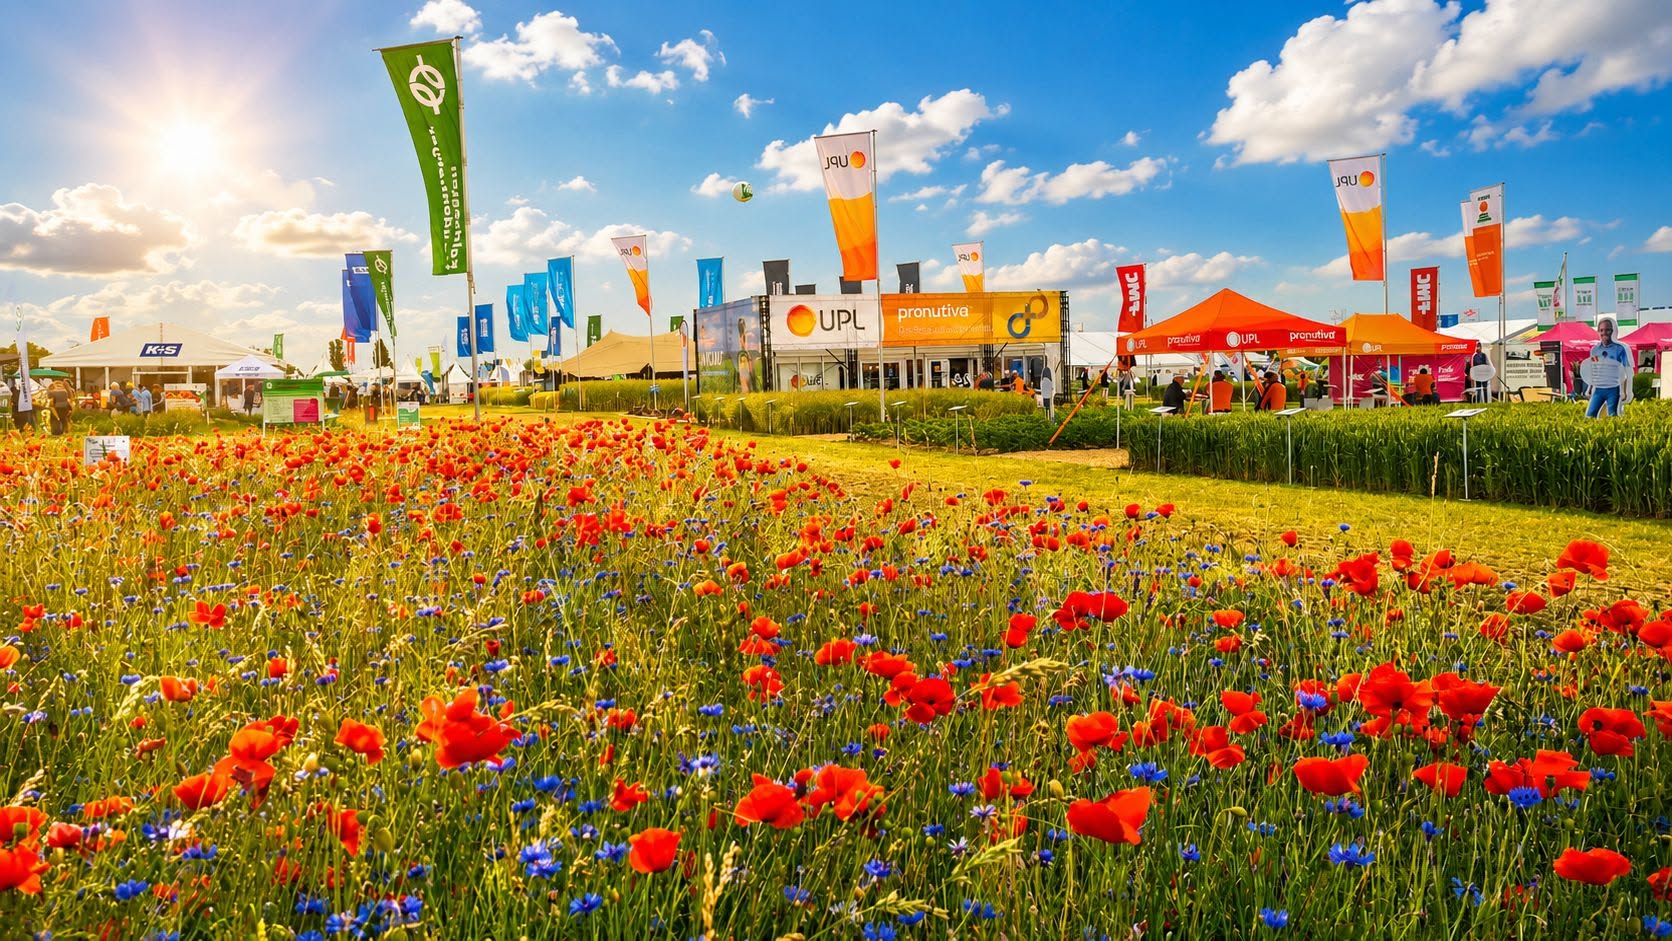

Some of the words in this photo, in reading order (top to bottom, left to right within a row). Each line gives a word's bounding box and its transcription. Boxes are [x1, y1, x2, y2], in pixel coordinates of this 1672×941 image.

[819, 309, 865, 331] UPL
[898, 304, 969, 323] pronutiva
[1241, 332, 1260, 344] UPL
[145, 345, 178, 355] K+S
